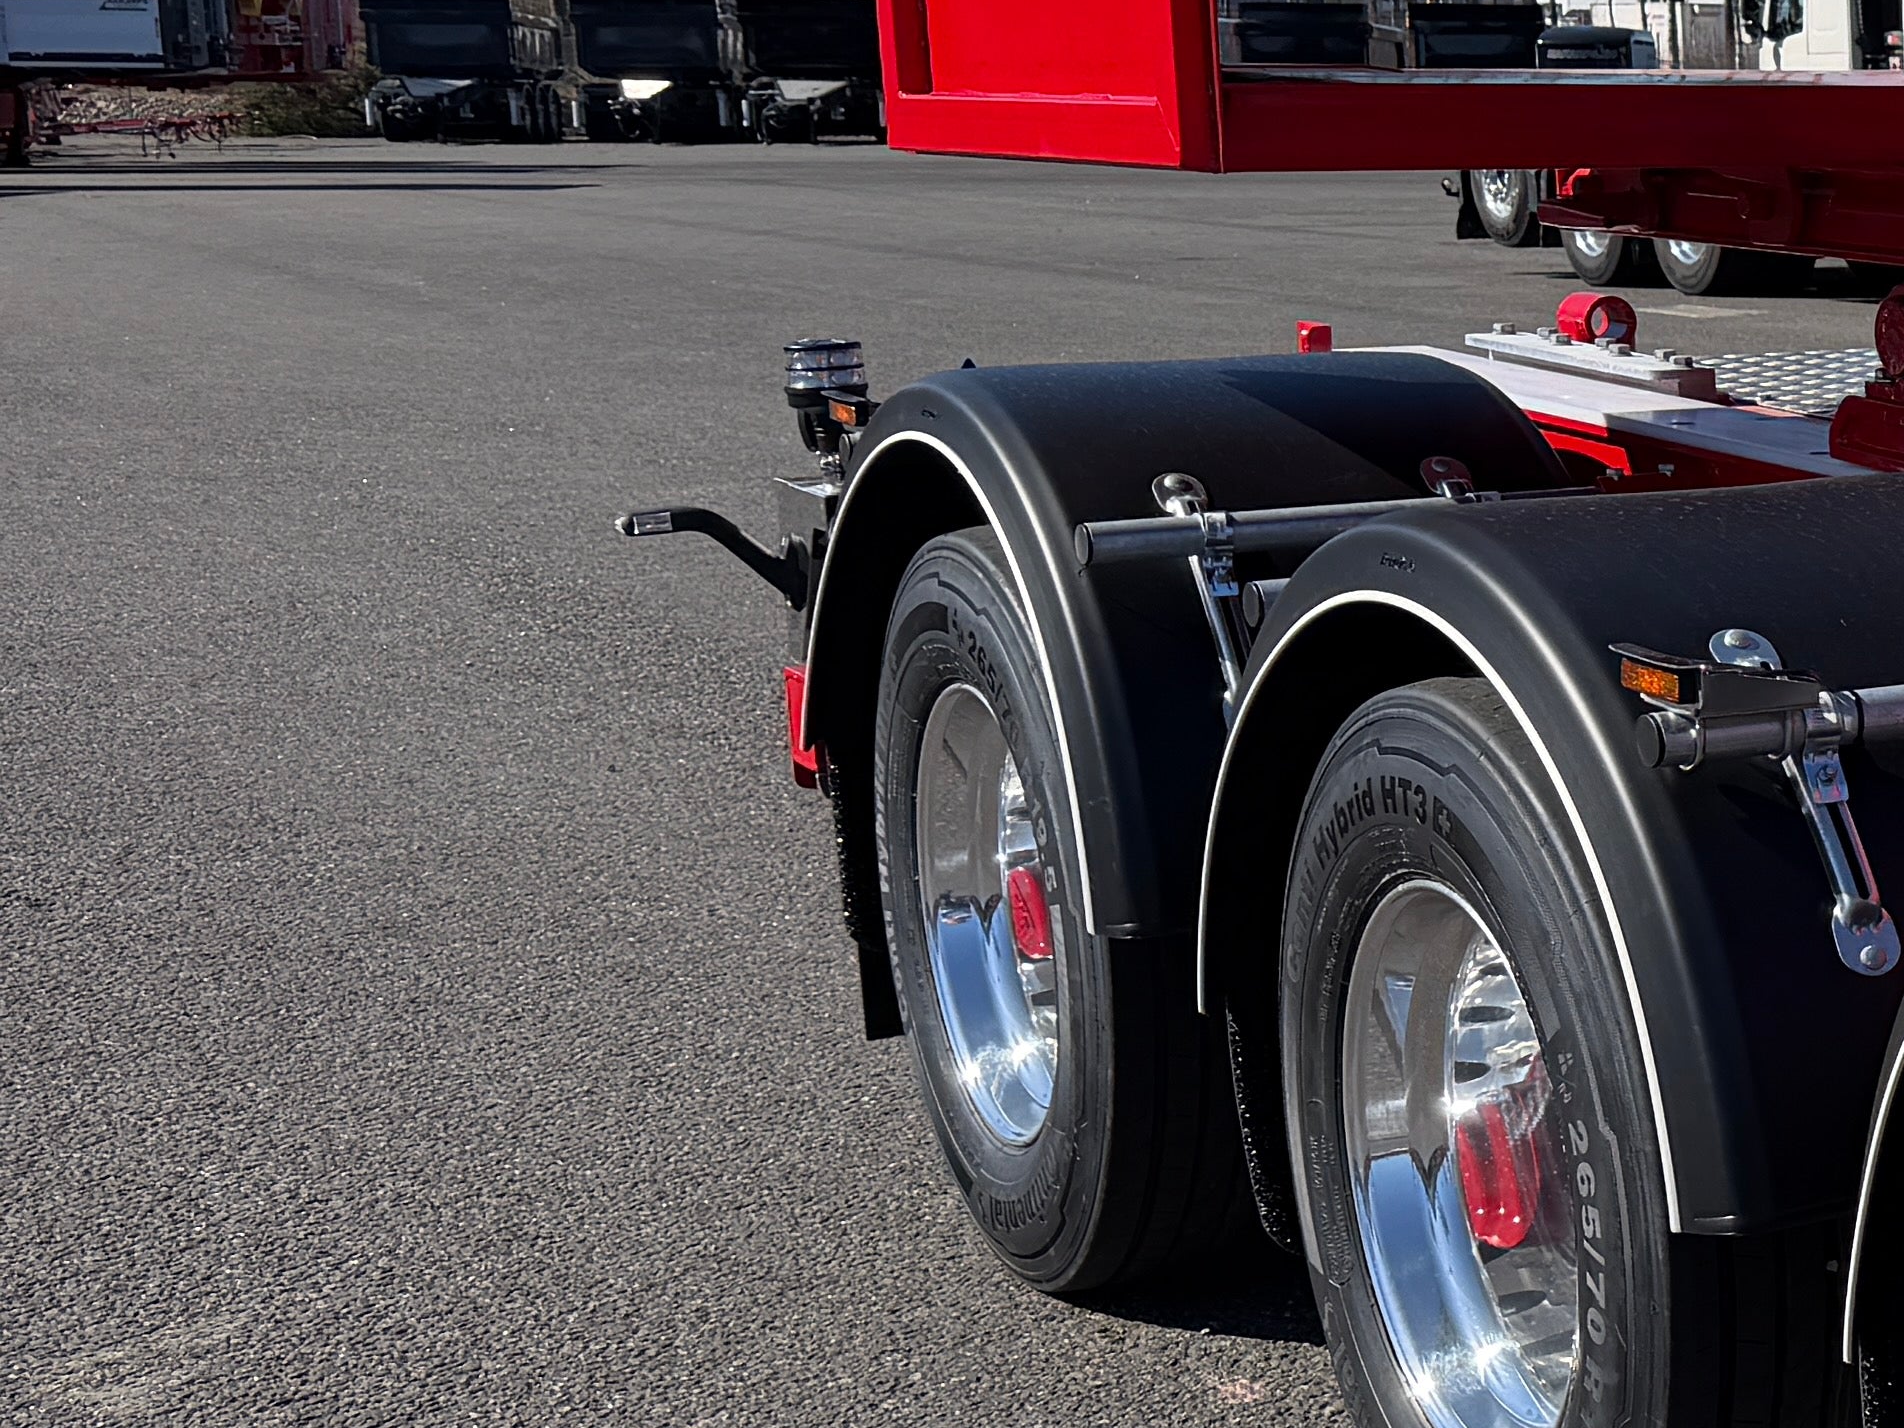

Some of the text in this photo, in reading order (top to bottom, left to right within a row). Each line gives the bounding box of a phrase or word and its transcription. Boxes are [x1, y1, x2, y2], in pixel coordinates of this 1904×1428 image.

[1312, 778, 1375, 870] Hybrid
[1380, 775, 1428, 826] HT3
[1568, 1119, 1607, 1346] 265/70
[1583, 1354, 1611, 1405] R
